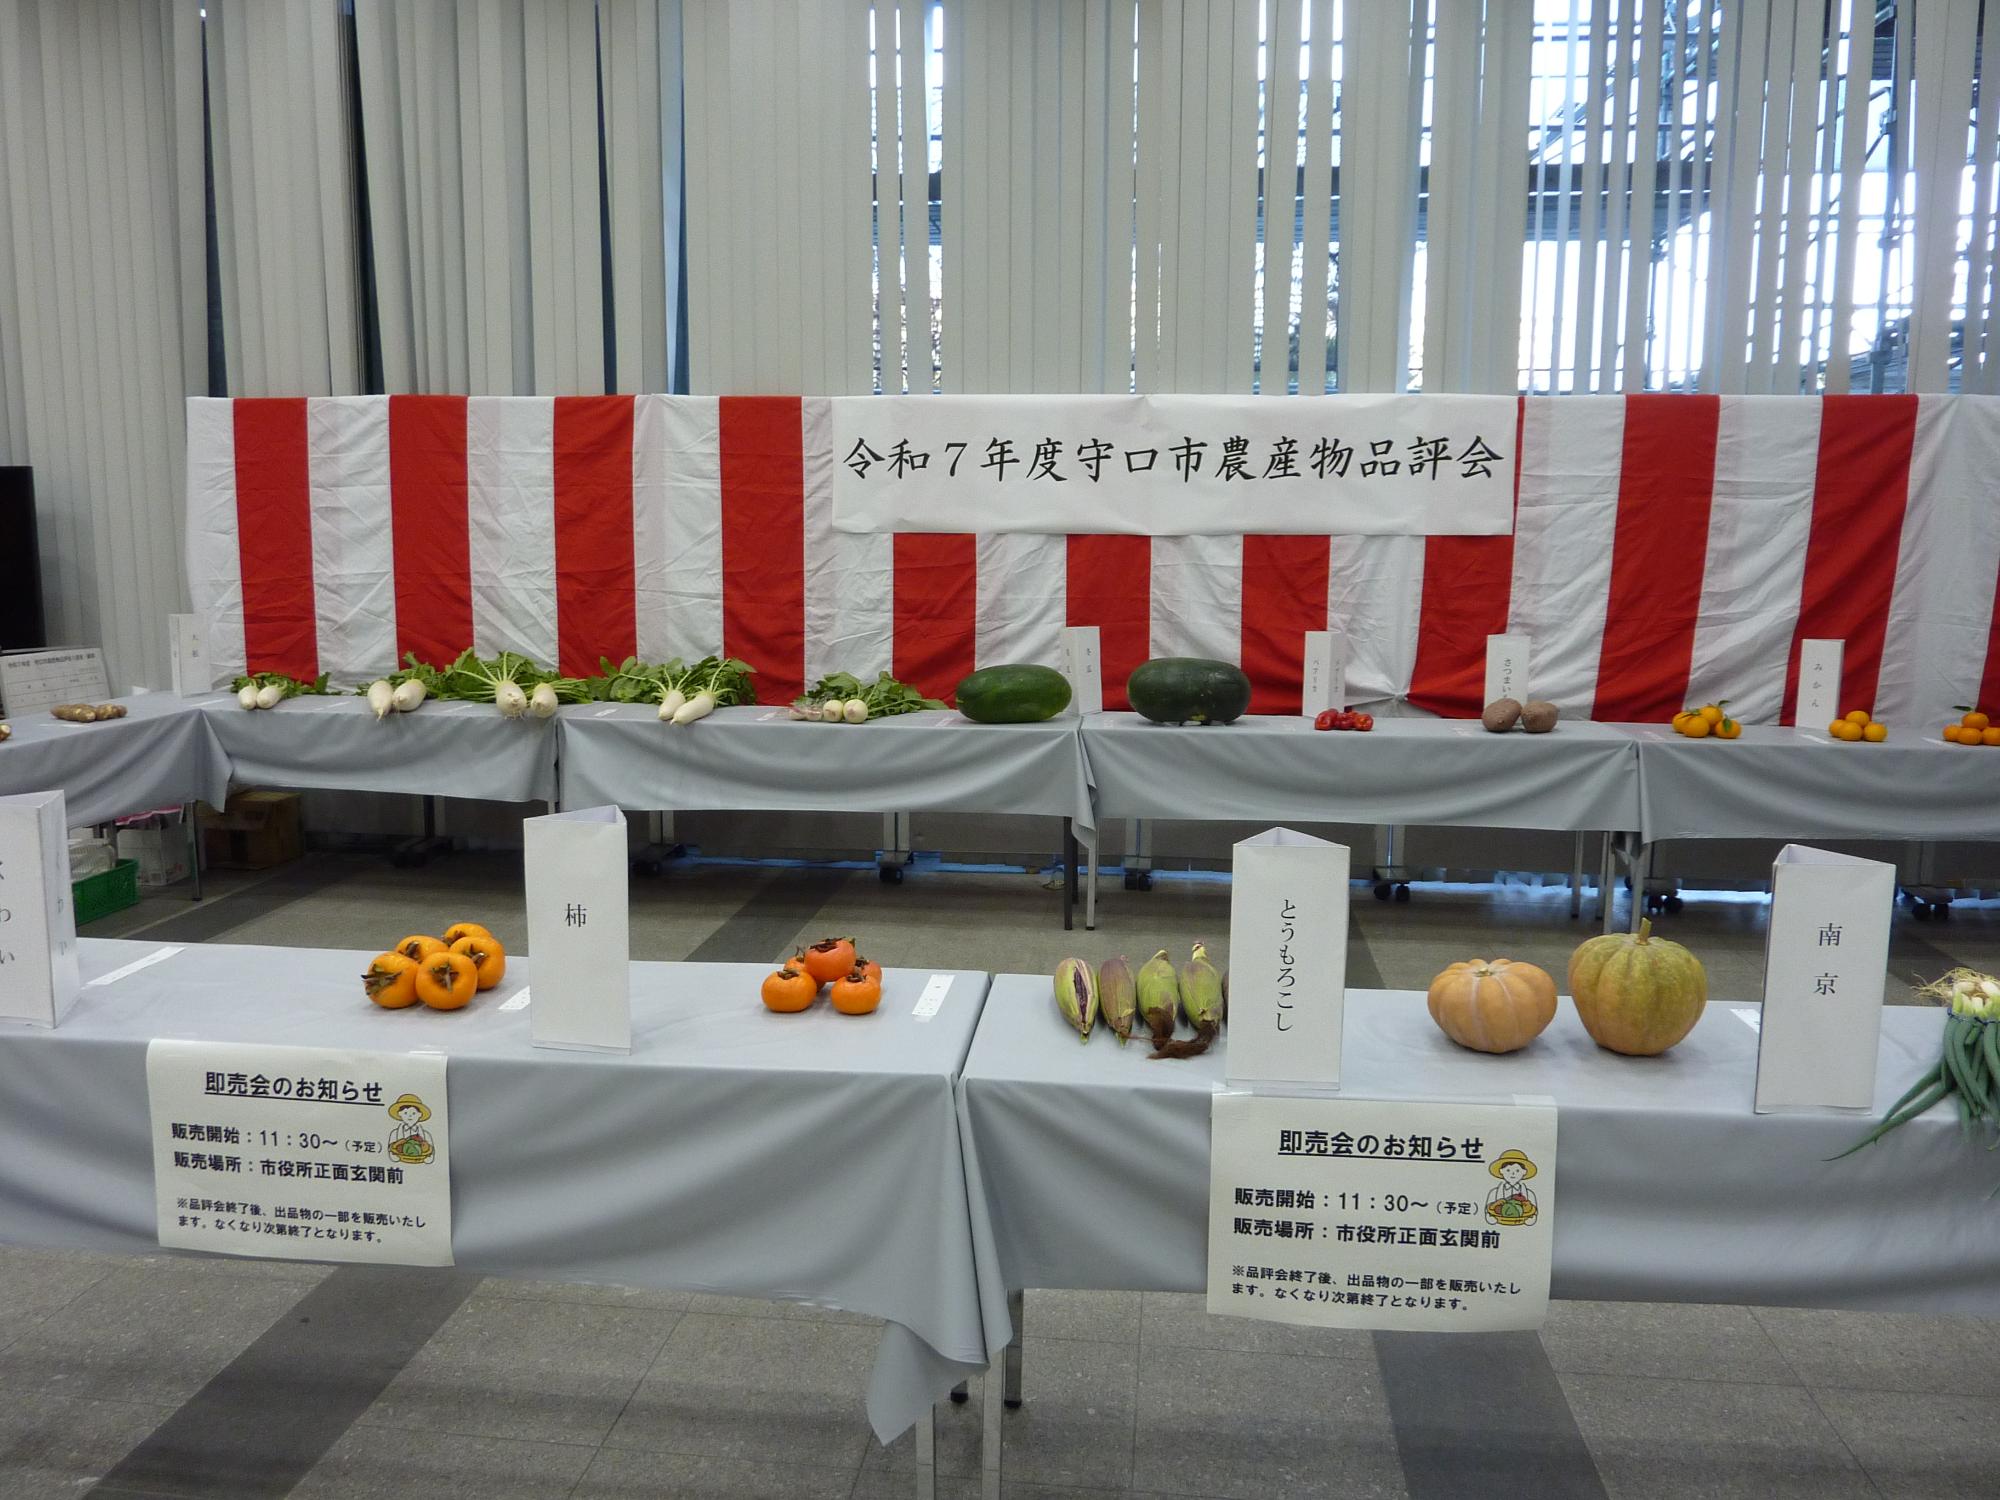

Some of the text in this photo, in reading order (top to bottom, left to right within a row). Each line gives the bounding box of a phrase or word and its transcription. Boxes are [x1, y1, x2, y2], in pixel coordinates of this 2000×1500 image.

[842, 434, 1504, 483] 令和7年度守口市農産物品評会
[1503, 657, 1512, 698] さつまい
[1811, 663, 1823, 708] みかん
[564, 903, 587, 928] 柿
[1276, 899, 1296, 1032] とうもろこし
[1813, 922, 1843, 996] 南京
[205, 1072, 383, 1103] 即売会のお知らせ
[1280, 1130, 1484, 1160] 即売会のお知らせ
[174, 1152, 404, 1184] 販売場所：市役所正面玄関前
[177, 1198, 426, 1228] ※品評会終了後、出品物の一部を販売いたし
[178, 1215, 382, 1243] ます。なくなり次第終了となります。
[1233, 1217, 1500, 1249] 販売場所：市役所正面玄関前
[1232, 1265, 1521, 1295] ※品評会終了後、出品物の一部を販売いたし
[1232, 1283, 1468, 1311] ます。なくなり次第終了となります。
